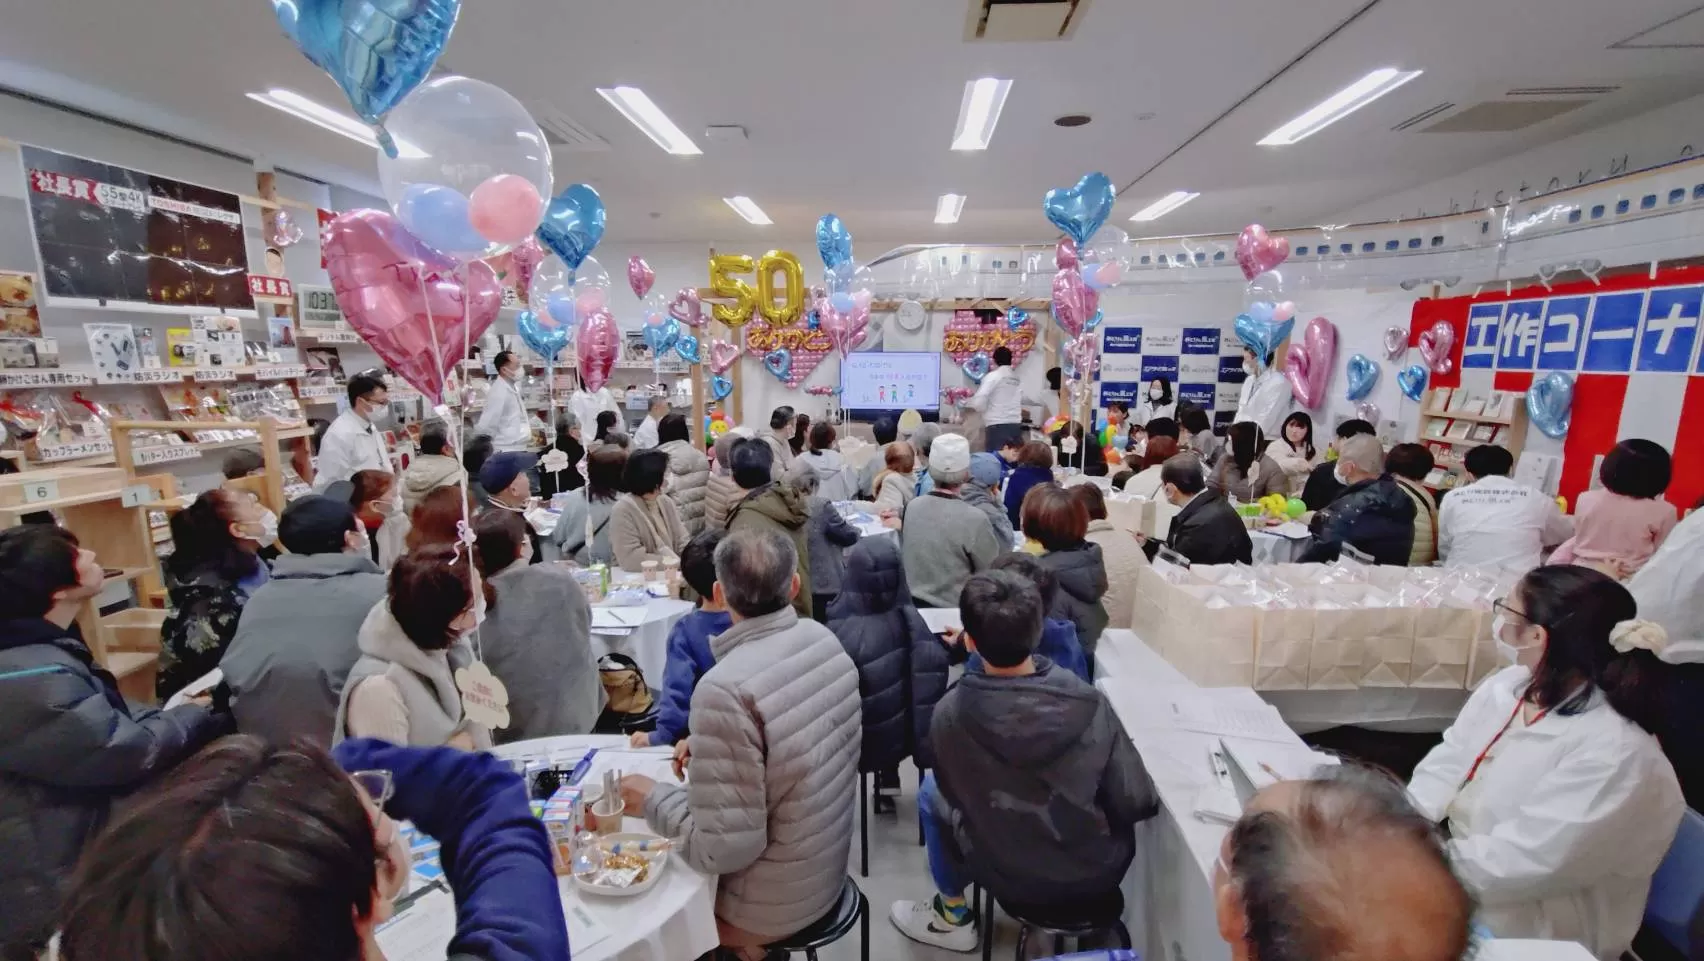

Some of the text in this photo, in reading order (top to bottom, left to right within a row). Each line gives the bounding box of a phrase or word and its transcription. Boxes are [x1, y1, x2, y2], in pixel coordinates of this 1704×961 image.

[36, 172, 90, 200] 社長賞
[250, 277, 290, 296] 社長賞
[708, 249, 804, 328] 50
[134, 371, 179, 382] 防災ラジオ
[195, 370, 234, 379] 防災ラジオ
[37, 486, 48, 498] 6
[131, 492, 138, 503] 1
